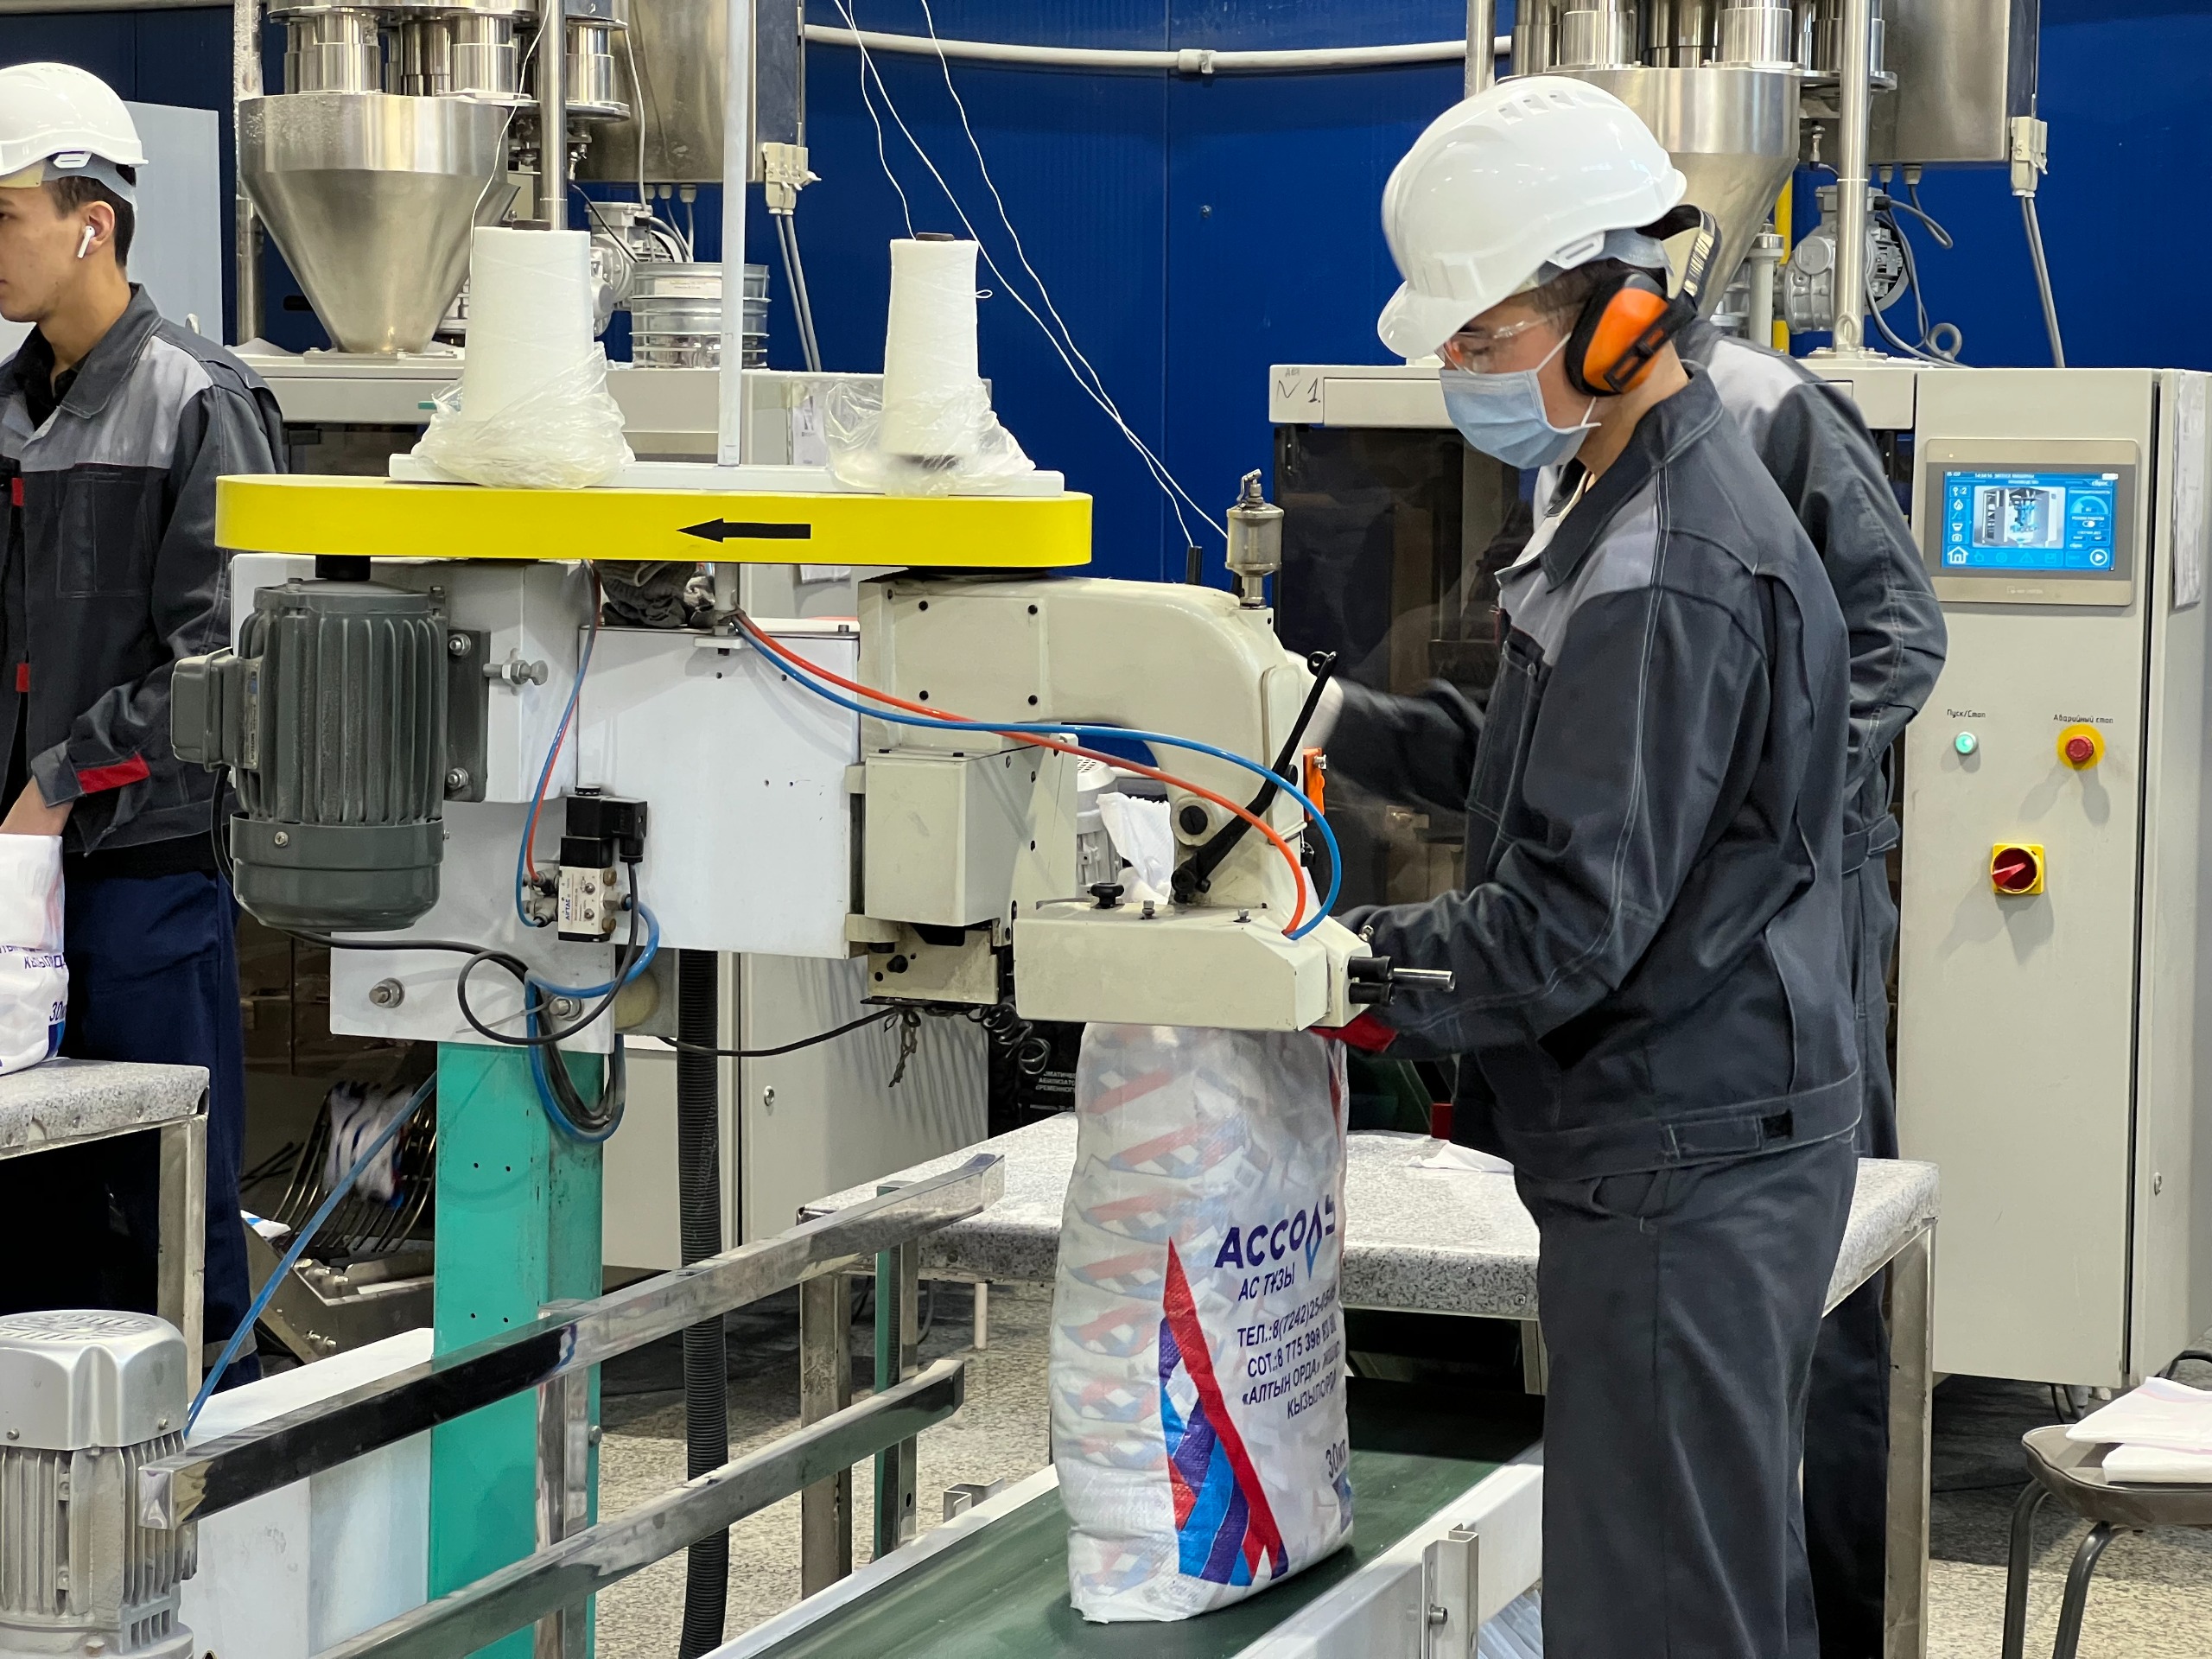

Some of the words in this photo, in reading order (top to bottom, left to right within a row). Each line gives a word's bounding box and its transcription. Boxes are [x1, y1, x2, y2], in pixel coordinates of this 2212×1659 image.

[1947, 709, 1986, 719] Пуск/Стоп
[2053, 714, 2094, 724] Аварийный
[1238, 1276, 1260, 1301] АС
